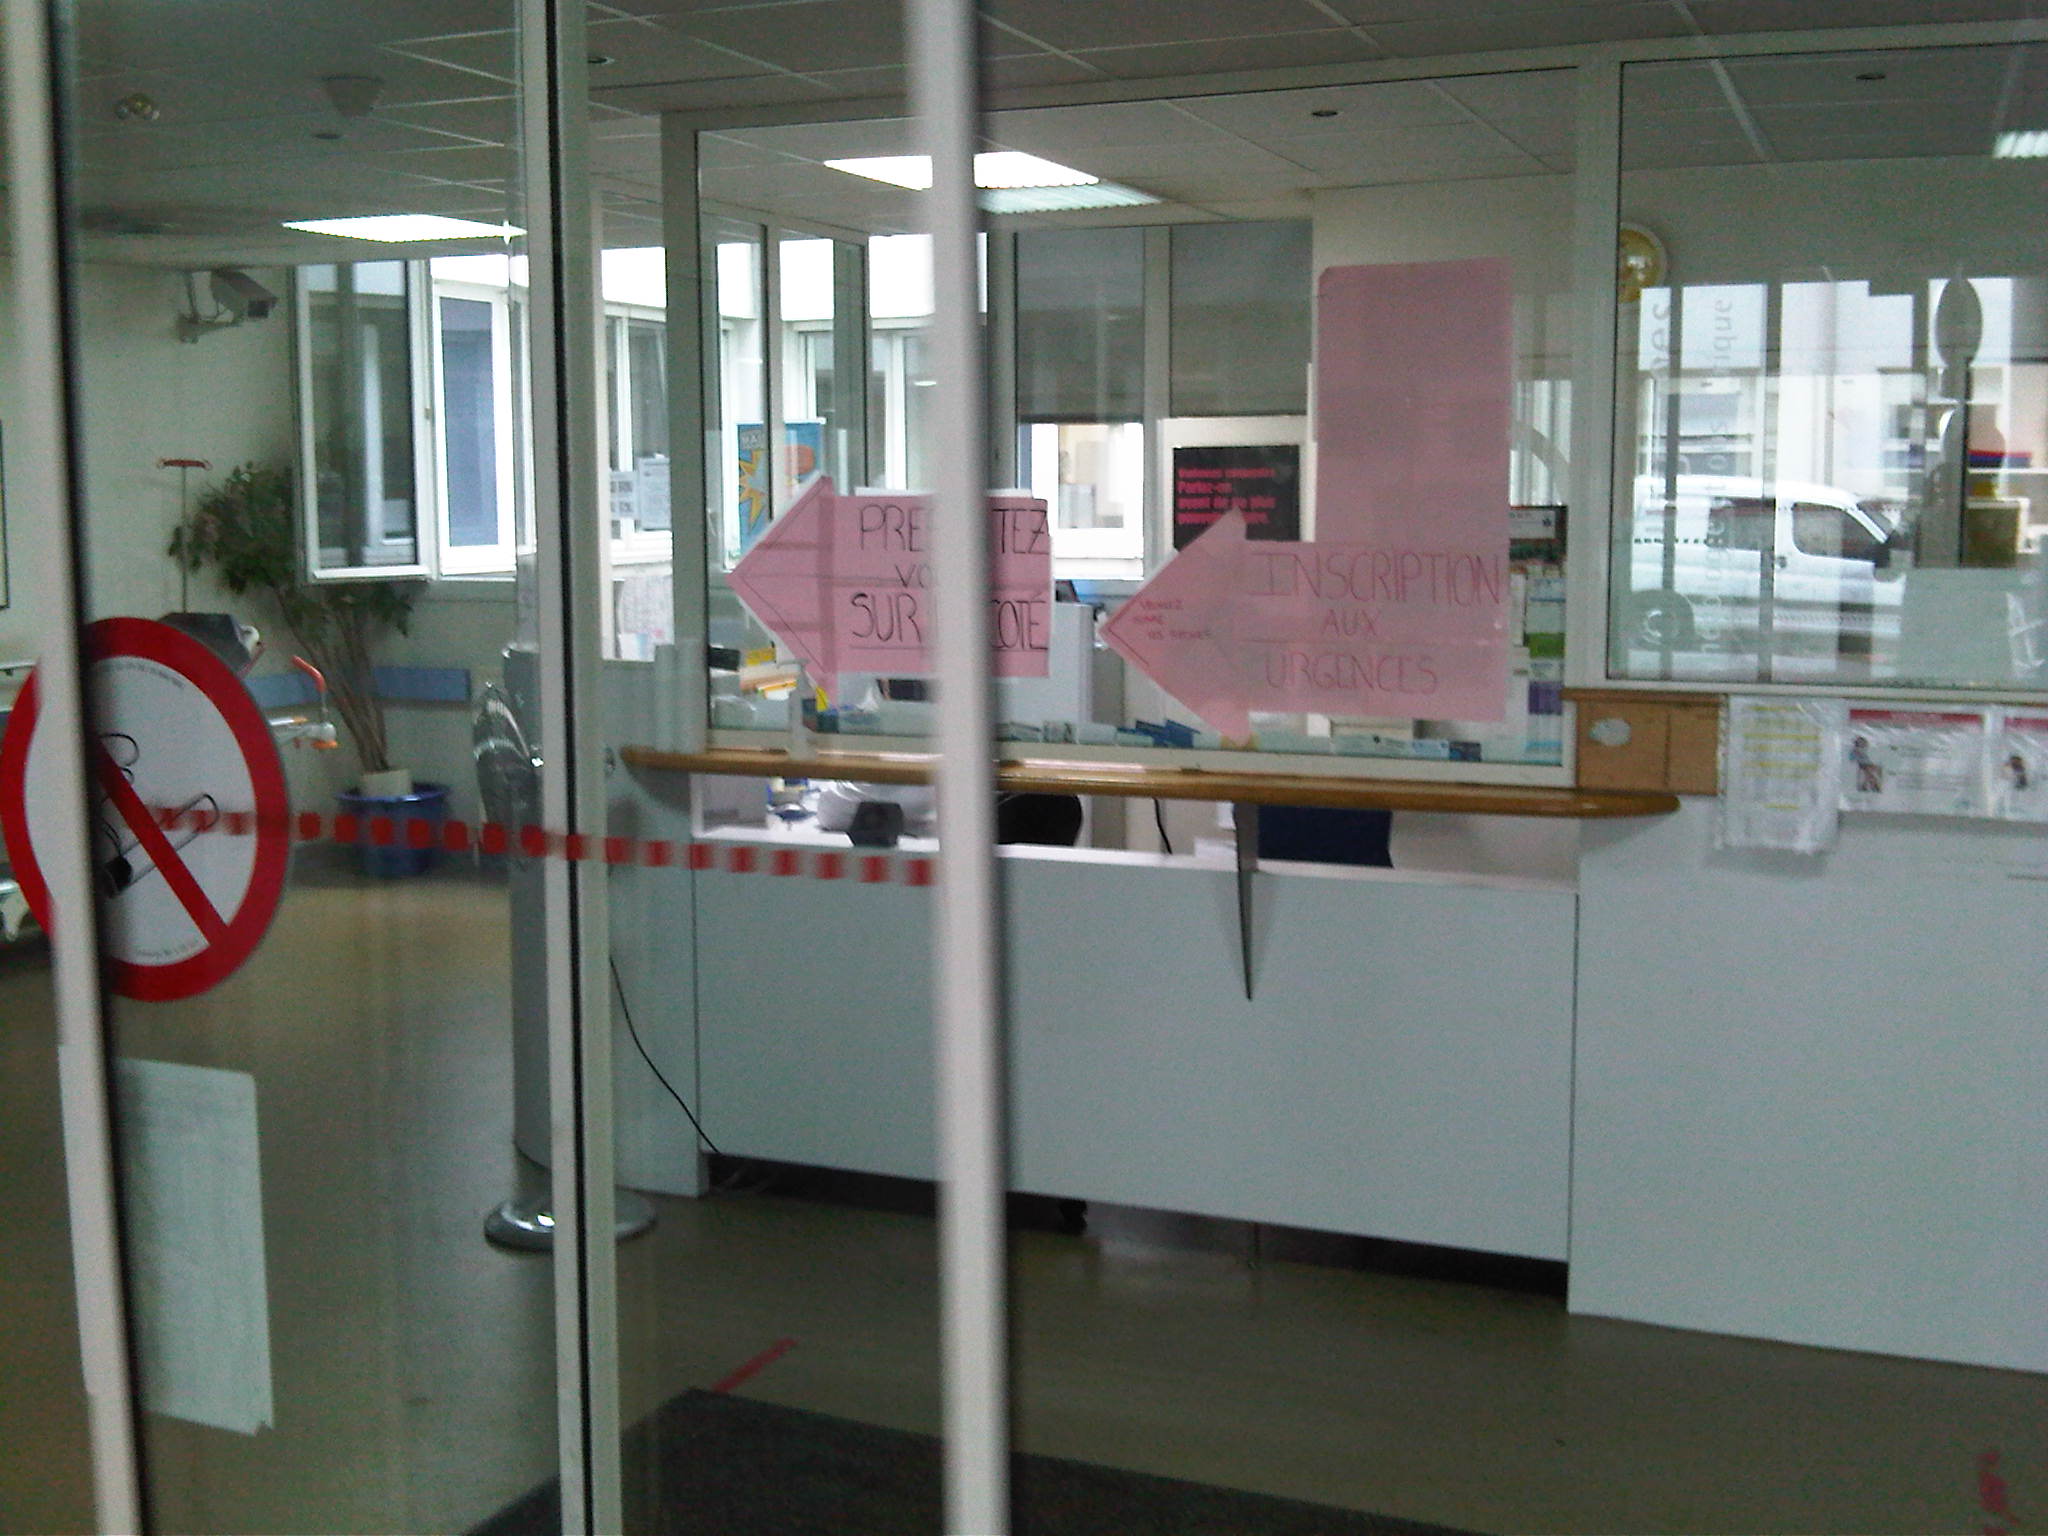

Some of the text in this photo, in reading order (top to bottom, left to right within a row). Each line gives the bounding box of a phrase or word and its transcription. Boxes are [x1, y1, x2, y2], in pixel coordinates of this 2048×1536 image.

[859, 503, 1050, 554] PRETEZ
[1248, 550, 1501, 607] INSCRIPTION
[850, 592, 923, 643] SUR
[1321, 607, 1382, 637] AUX
[1260, 650, 1439, 695] URGENCES
